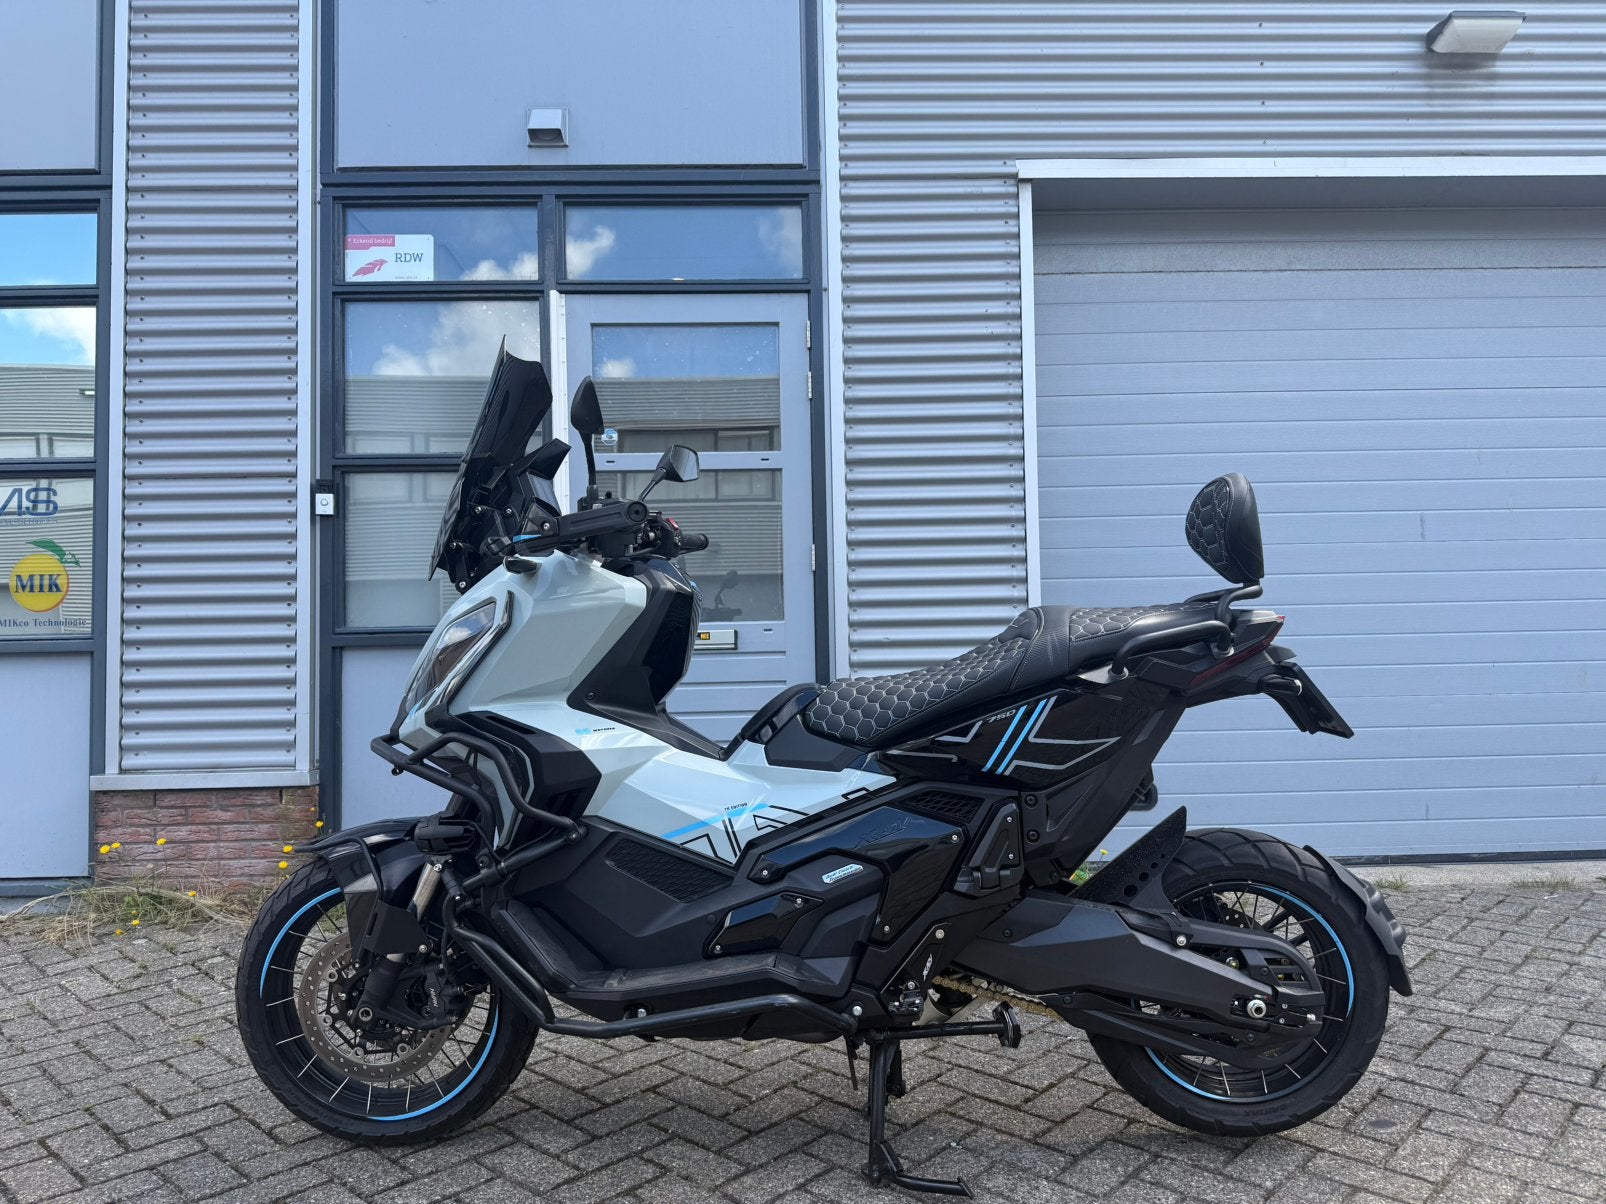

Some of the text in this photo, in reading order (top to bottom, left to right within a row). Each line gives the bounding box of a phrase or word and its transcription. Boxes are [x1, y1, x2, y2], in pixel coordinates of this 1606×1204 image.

[394, 252, 424, 263] RDW
[14, 574, 63, 593] MIK
[32, 618, 87, 628] Technologie
